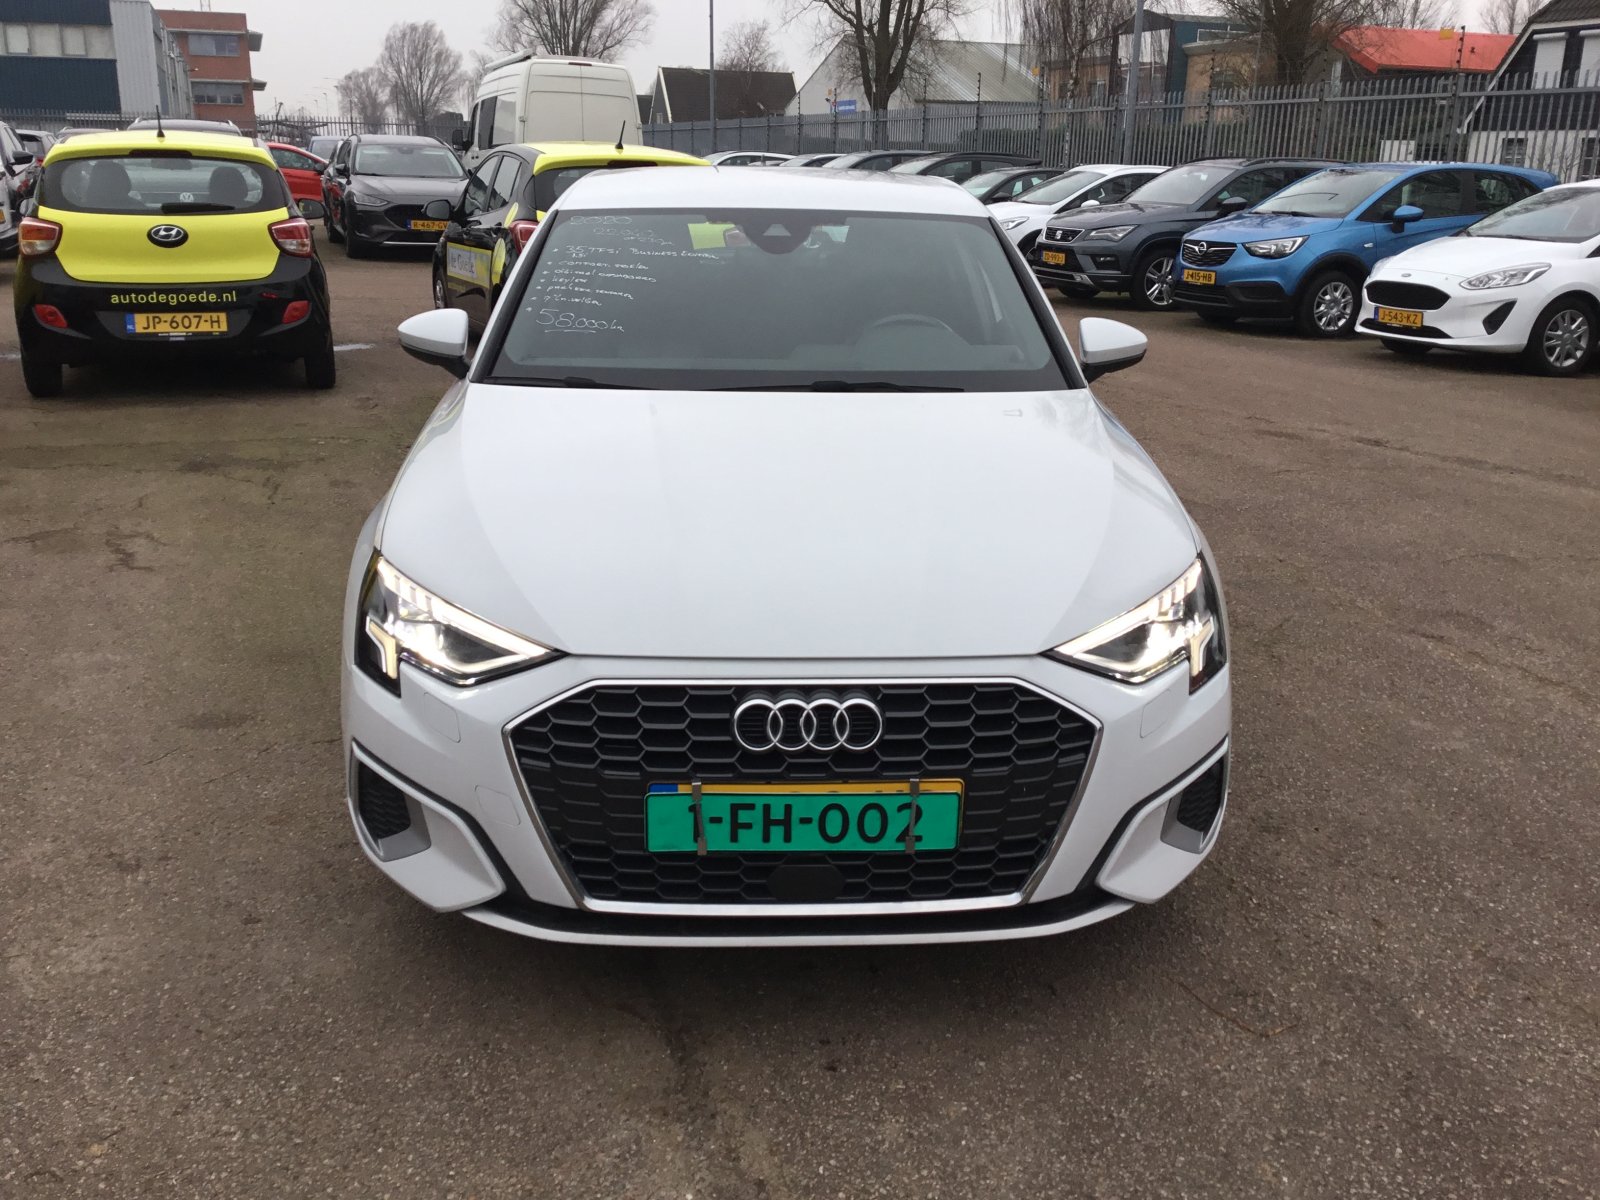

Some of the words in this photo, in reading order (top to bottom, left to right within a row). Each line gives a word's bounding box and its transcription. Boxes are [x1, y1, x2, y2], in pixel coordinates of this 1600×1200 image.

[110, 290, 237, 305] autodegoede.nl
[142, 315, 221, 330] JP-607-H
[1380, 310, 1418, 325] J-543-KZ
[688, 802, 923, 844] 1-FH-002
